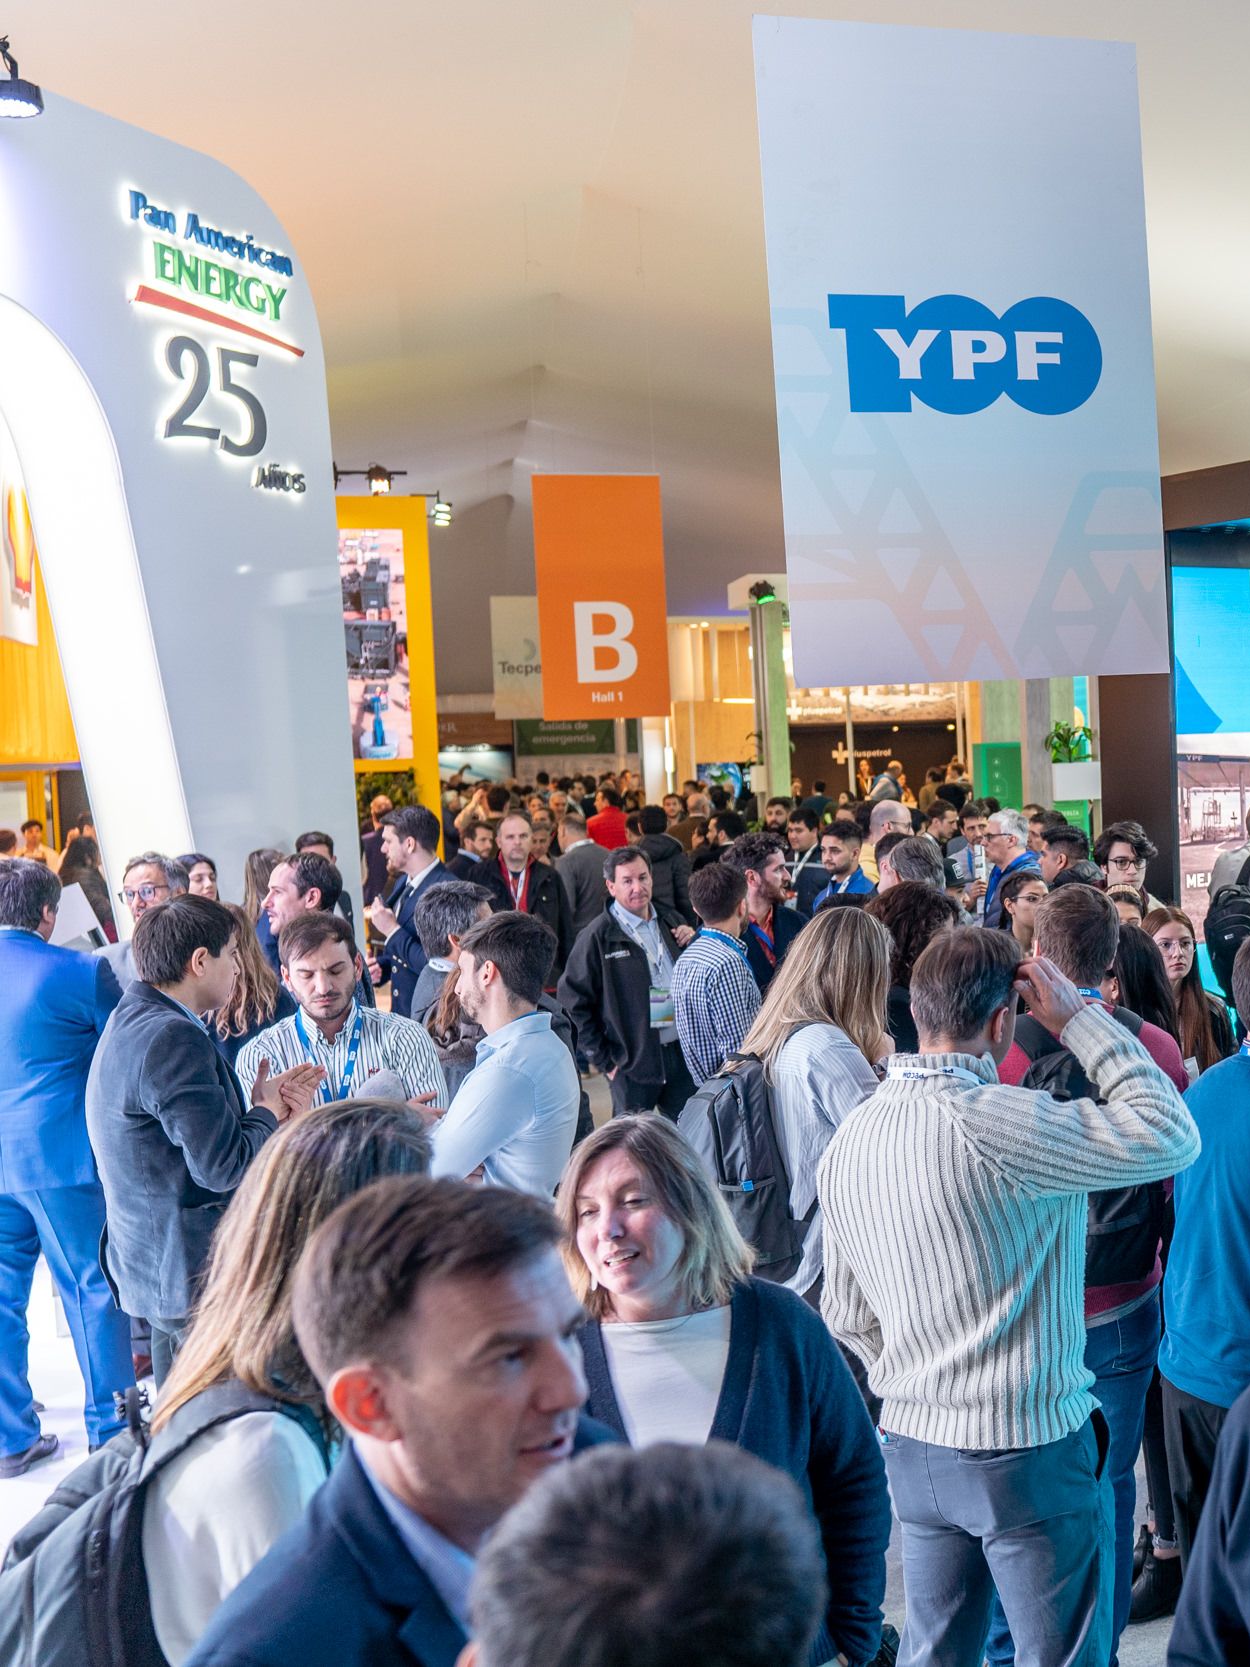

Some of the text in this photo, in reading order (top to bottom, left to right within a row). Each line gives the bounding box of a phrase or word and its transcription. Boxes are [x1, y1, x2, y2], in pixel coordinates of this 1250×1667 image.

[129, 189, 294, 277] Pan American
[153, 240, 287, 321] ENERGY
[873, 328, 1064, 381] YPF
[164, 335, 267, 457] 25
[573, 601, 639, 684] B
[592, 692, 624, 702] Hall 1
[532, 734, 596, 745] emergencia
[574, 721, 588, 731] de
[852, 748, 892, 758] luspetrol
